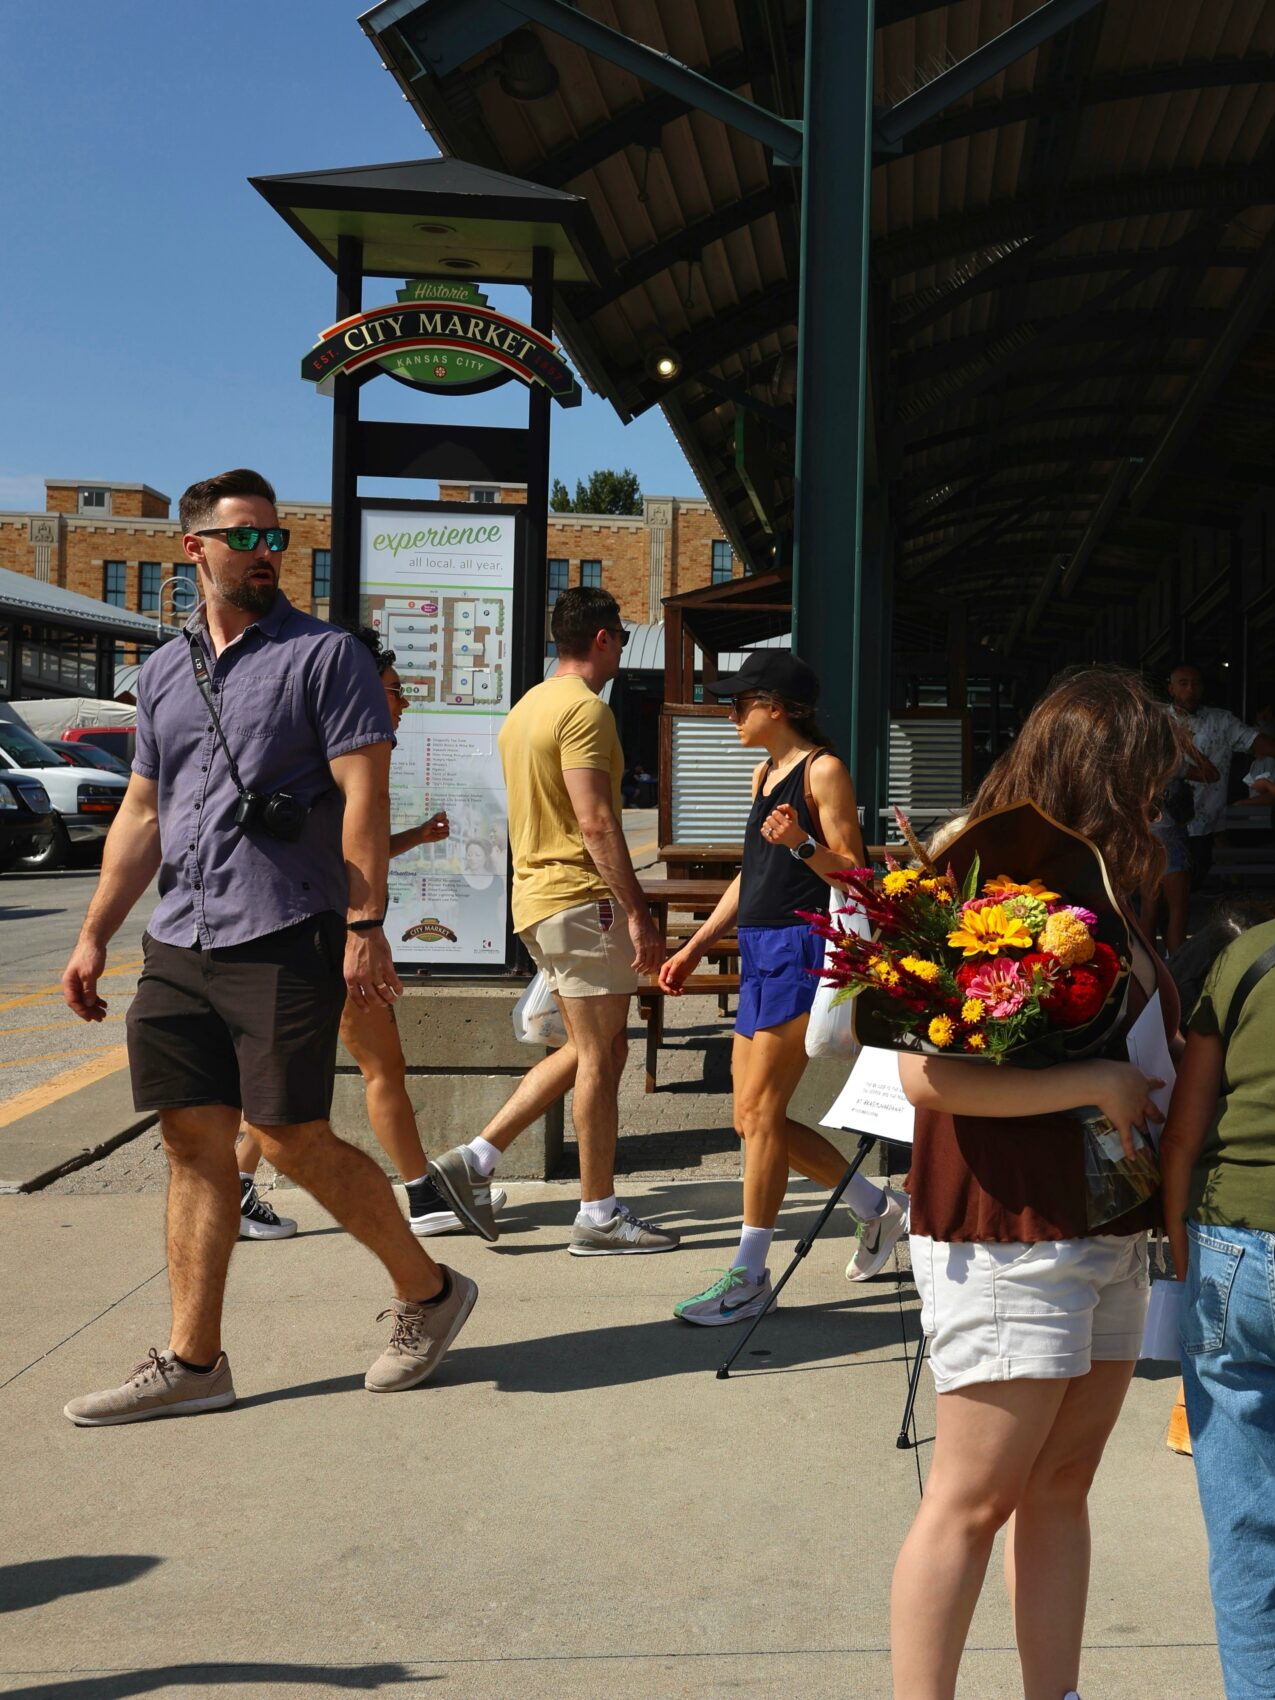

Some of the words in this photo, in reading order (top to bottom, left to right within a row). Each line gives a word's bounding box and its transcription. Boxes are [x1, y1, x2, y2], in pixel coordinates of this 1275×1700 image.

[414, 283, 469, 301] Historic
[343, 314, 404, 351] CITY
[418, 313, 537, 360] MARKET
[312, 350, 340, 370] EST.
[396, 355, 448, 368] KANSAS
[456, 356, 485, 371] CITY
[372, 525, 502, 557] experience
[409, 558, 422, 567] all
[426, 558, 455, 569] local.
[459, 560, 473, 569] all
[476, 563, 503, 571] year.
[409, 928, 424, 936] CITY
